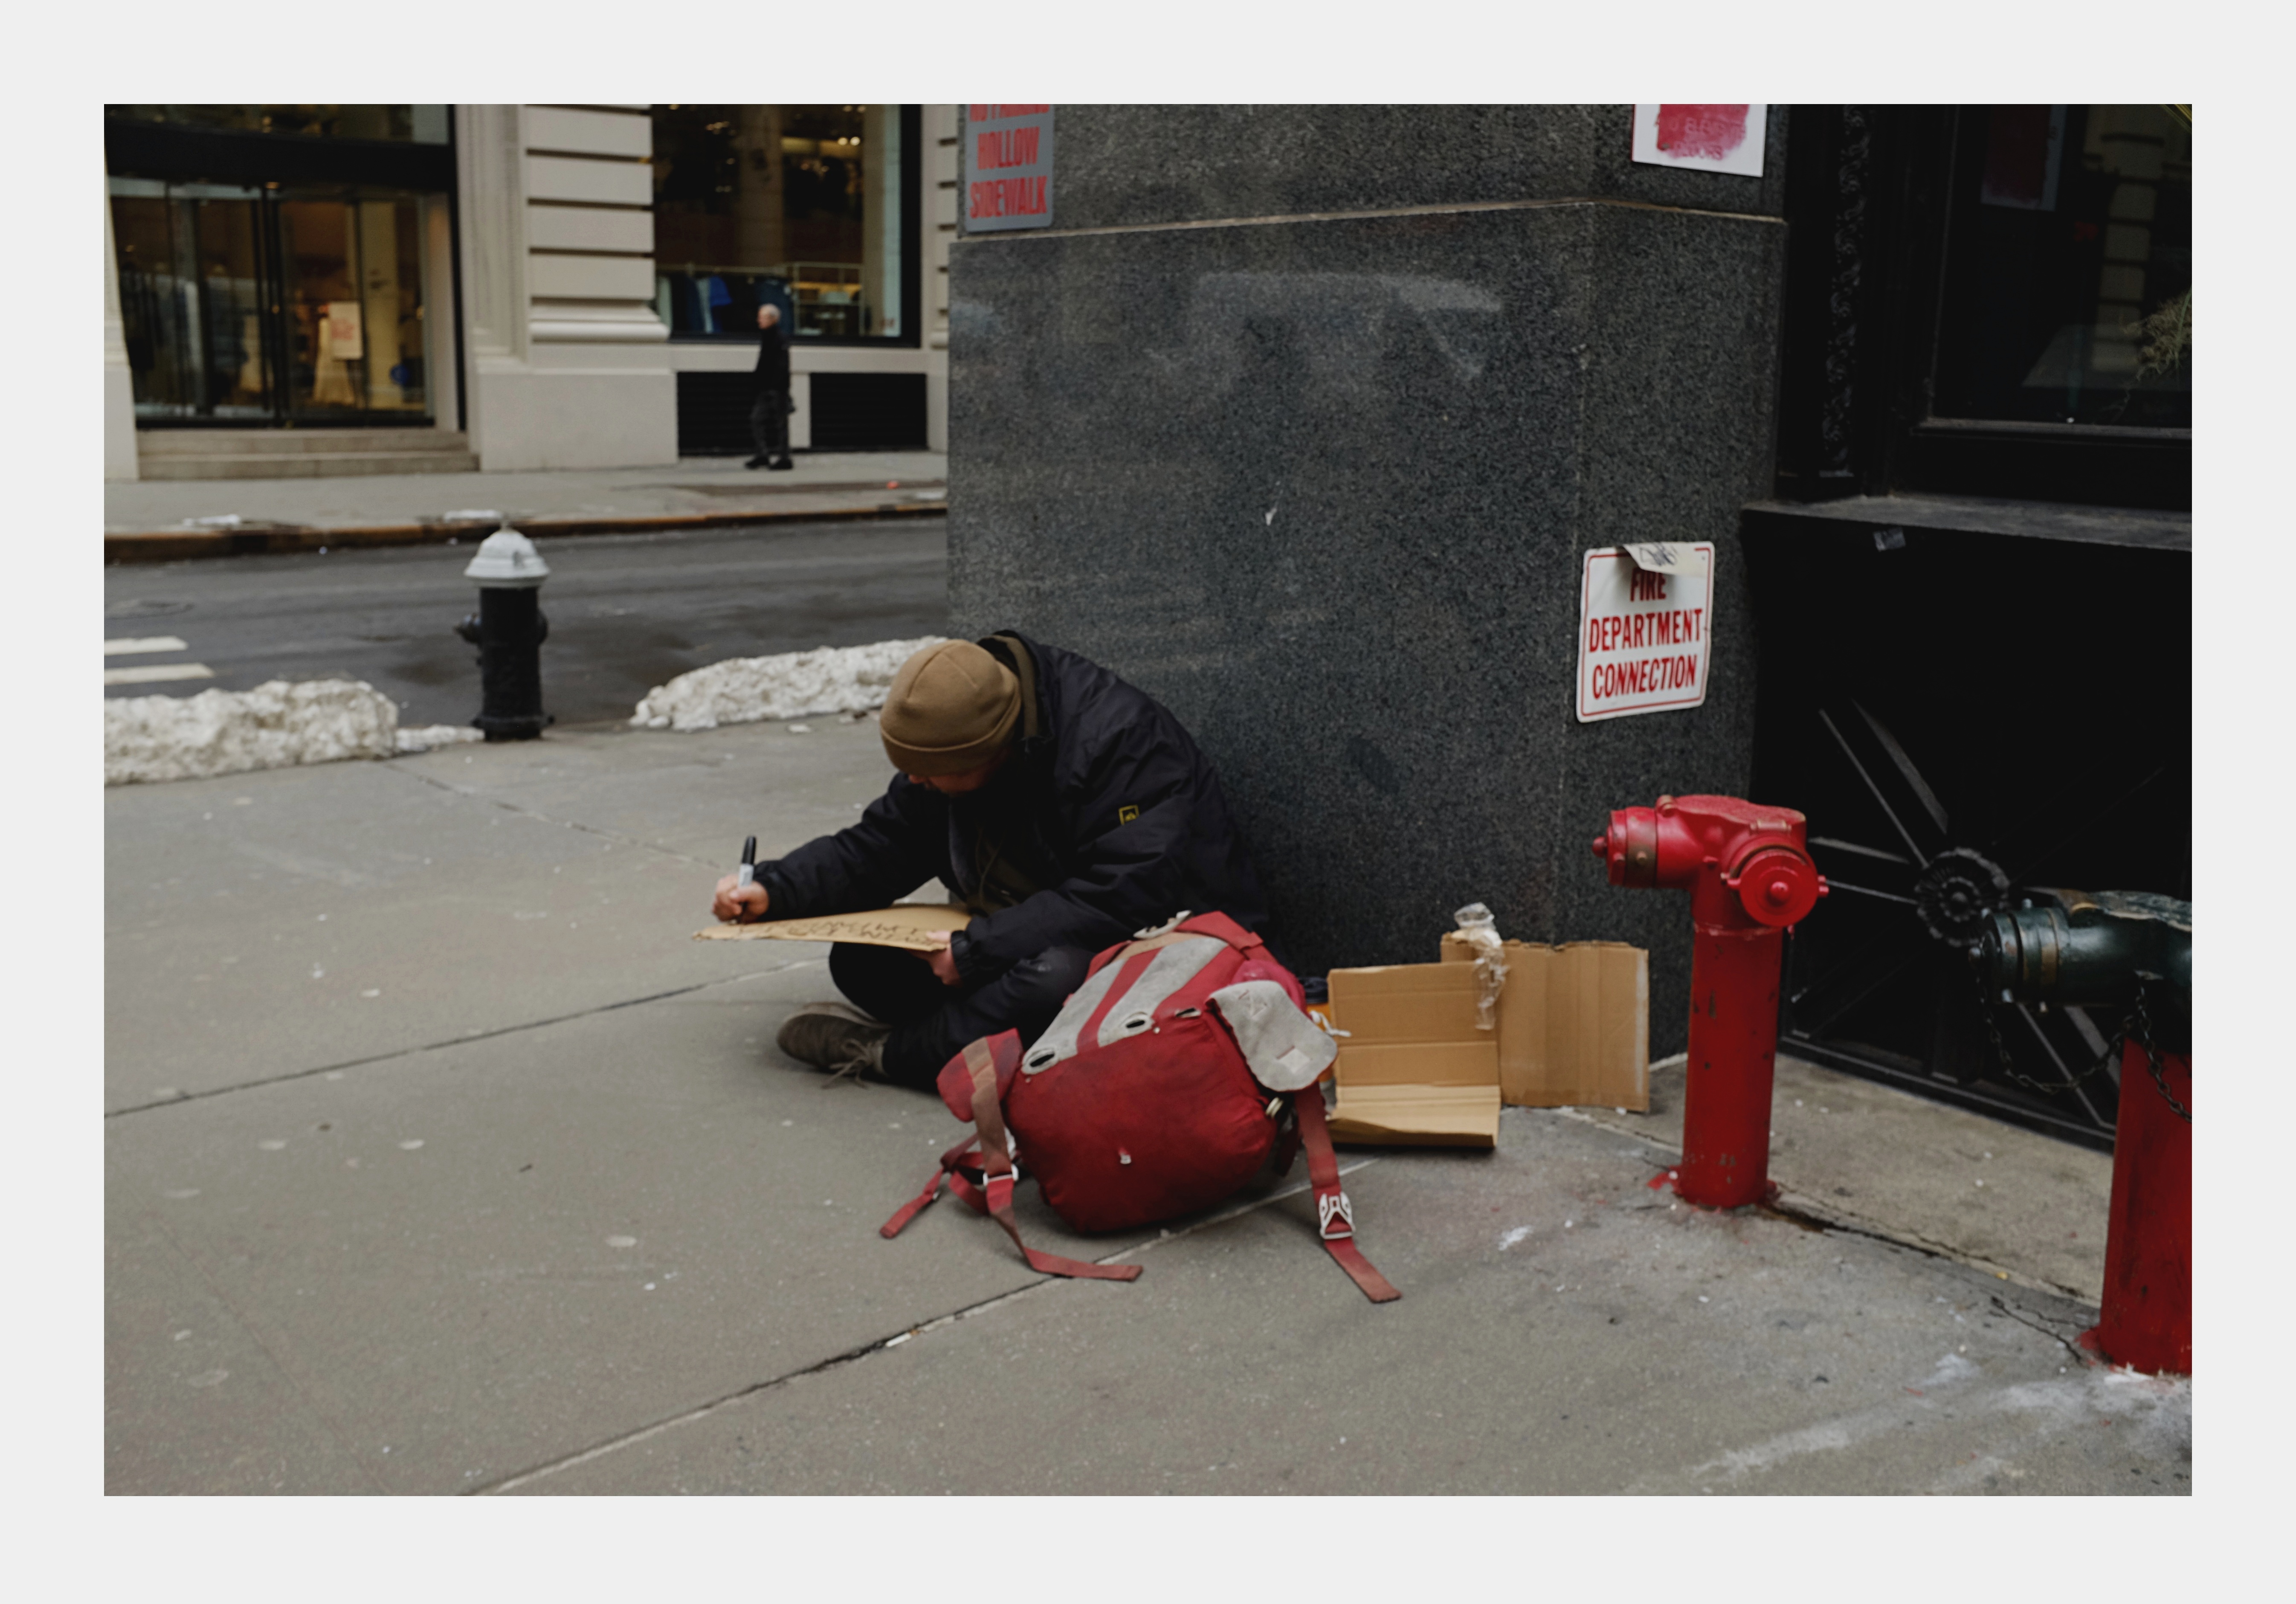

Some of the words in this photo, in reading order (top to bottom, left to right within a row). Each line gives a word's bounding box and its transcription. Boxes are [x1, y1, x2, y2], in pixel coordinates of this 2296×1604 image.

[970, 176, 1047, 218] SIDEWALK
[1630, 568, 1667, 601] FIRE
[1589, 608, 1703, 653] DEPARTMENT
[1592, 655, 1697, 699] CONNECTION
